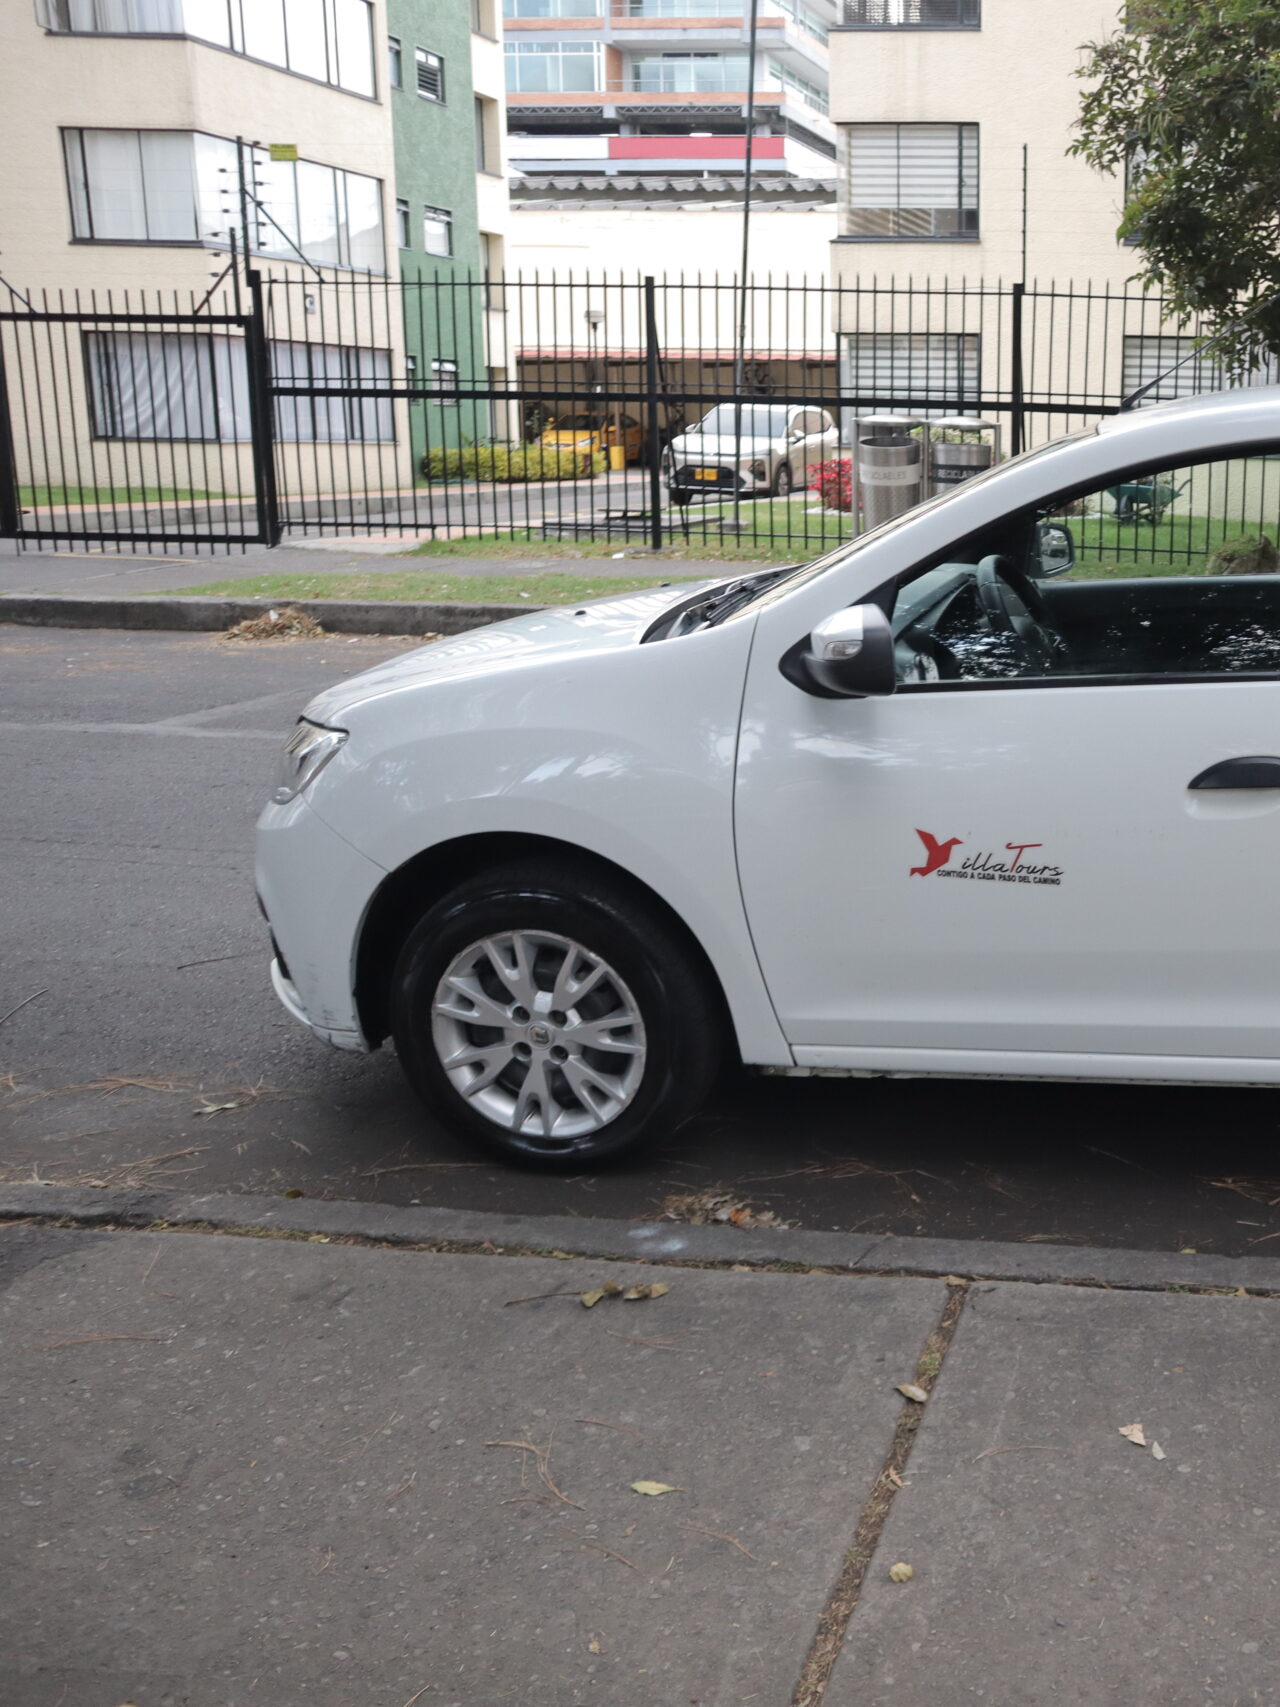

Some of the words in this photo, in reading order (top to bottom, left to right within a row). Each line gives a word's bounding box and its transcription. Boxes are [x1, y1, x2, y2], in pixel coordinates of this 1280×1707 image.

[937, 469, 981, 479] RECICLAB
[937, 869, 968, 879] CONTIGO
[998, 874, 1016, 882] PASO
[1018, 875, 1031, 883] DEL
[1033, 876, 1060, 885] CAMINO
